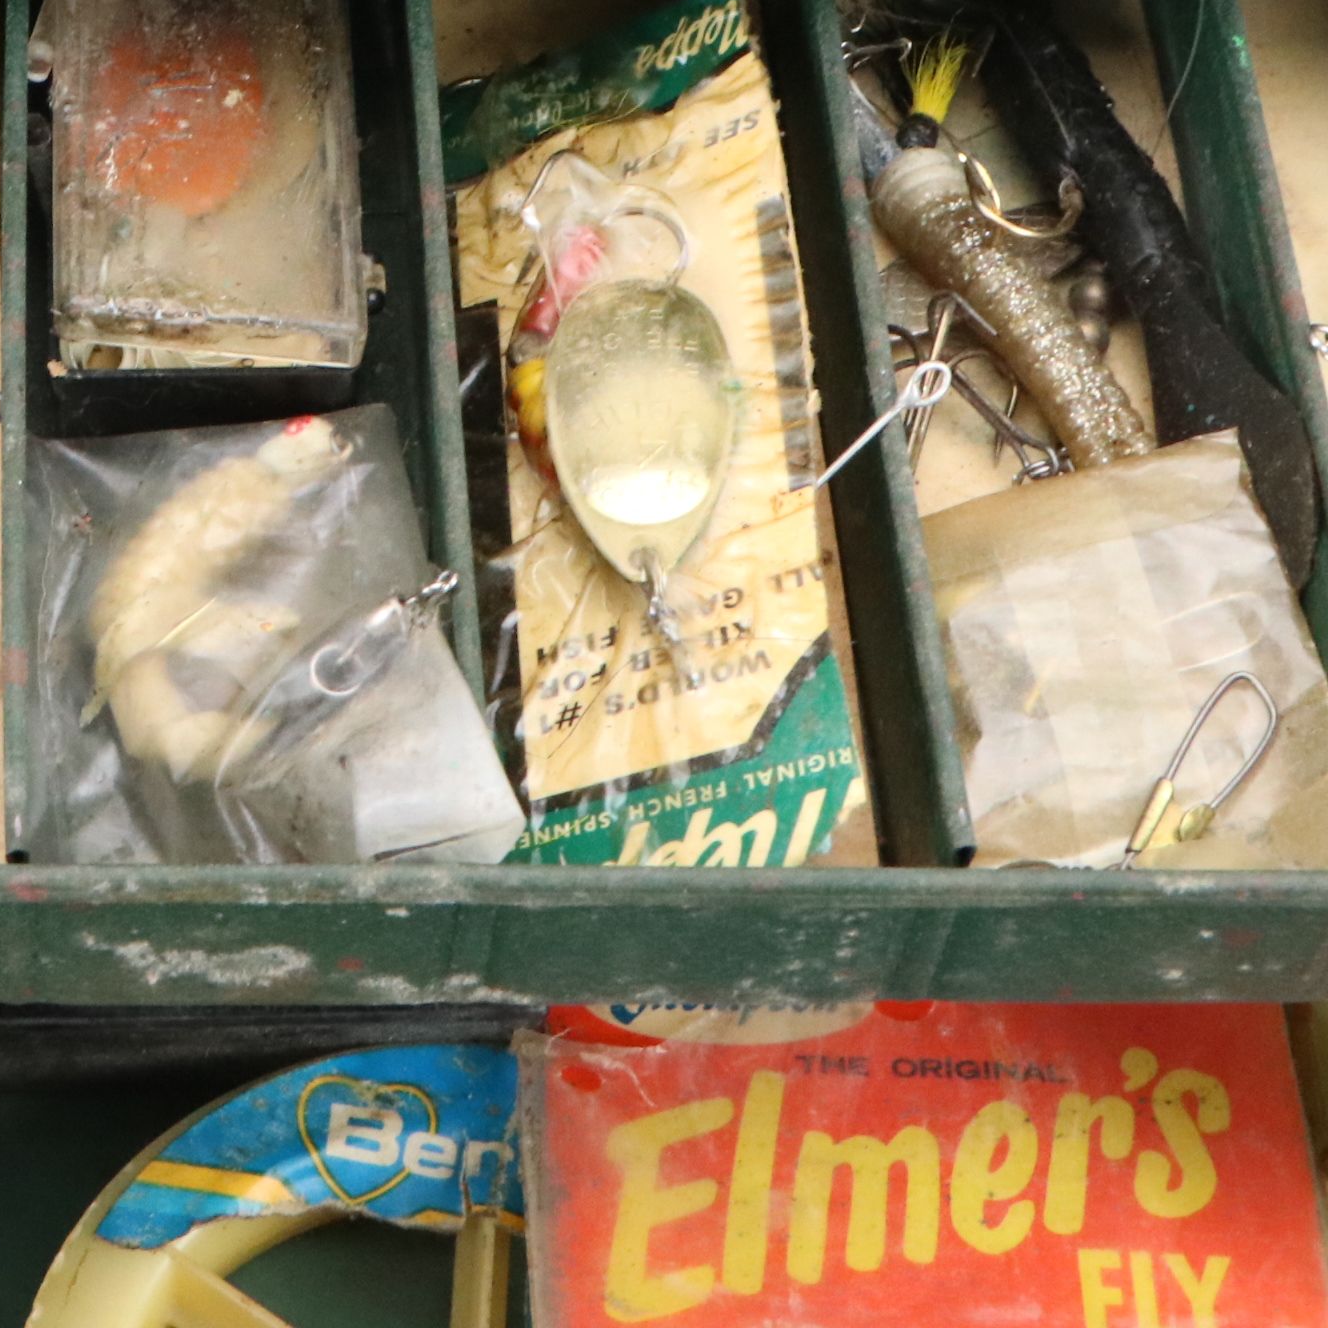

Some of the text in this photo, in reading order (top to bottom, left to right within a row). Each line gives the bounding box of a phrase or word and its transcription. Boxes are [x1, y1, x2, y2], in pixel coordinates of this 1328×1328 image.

[703, 109, 760, 148] SEE
[536, 559, 825, 668] ALL GAE FISH
[536, 622, 754, 699] KILER FOR
[536, 648, 771, 735] WORLD'S #1
[511, 746, 857, 851] RIGINAL FRENCH SPINNE
[796, 1054, 1069, 1084] THE ORIGINAL
[326, 1102, 515, 1180] Ber
[603, 1044, 1232, 1322] Elmer's
[1076, 1247, 1231, 1328] FLY
